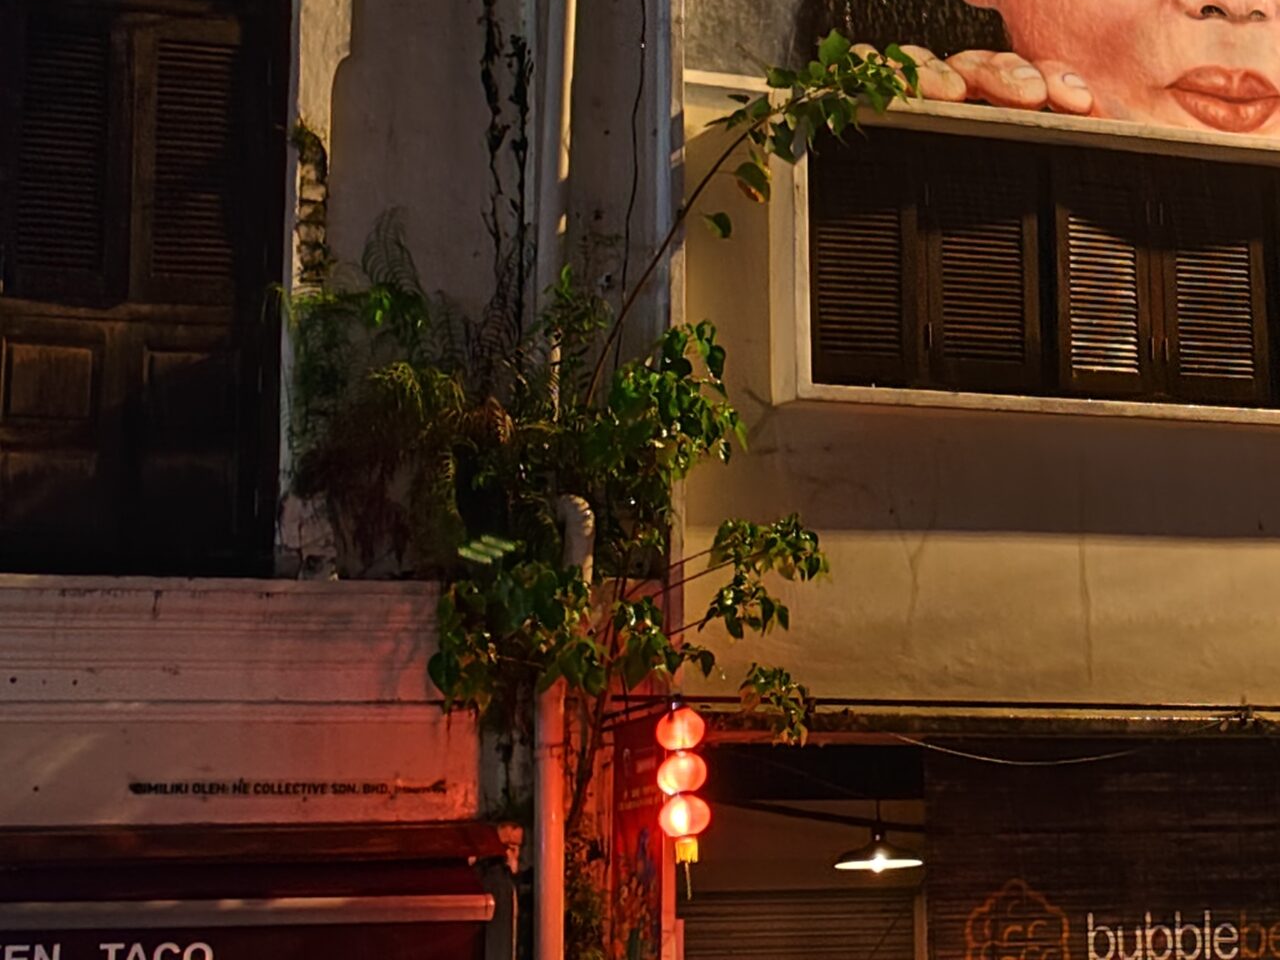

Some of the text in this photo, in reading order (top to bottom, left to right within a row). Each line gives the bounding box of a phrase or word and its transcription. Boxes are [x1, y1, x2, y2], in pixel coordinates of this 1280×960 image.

[253, 783, 328, 794] COLLECTIVE
[0, 942, 214, 960] EN TACO
